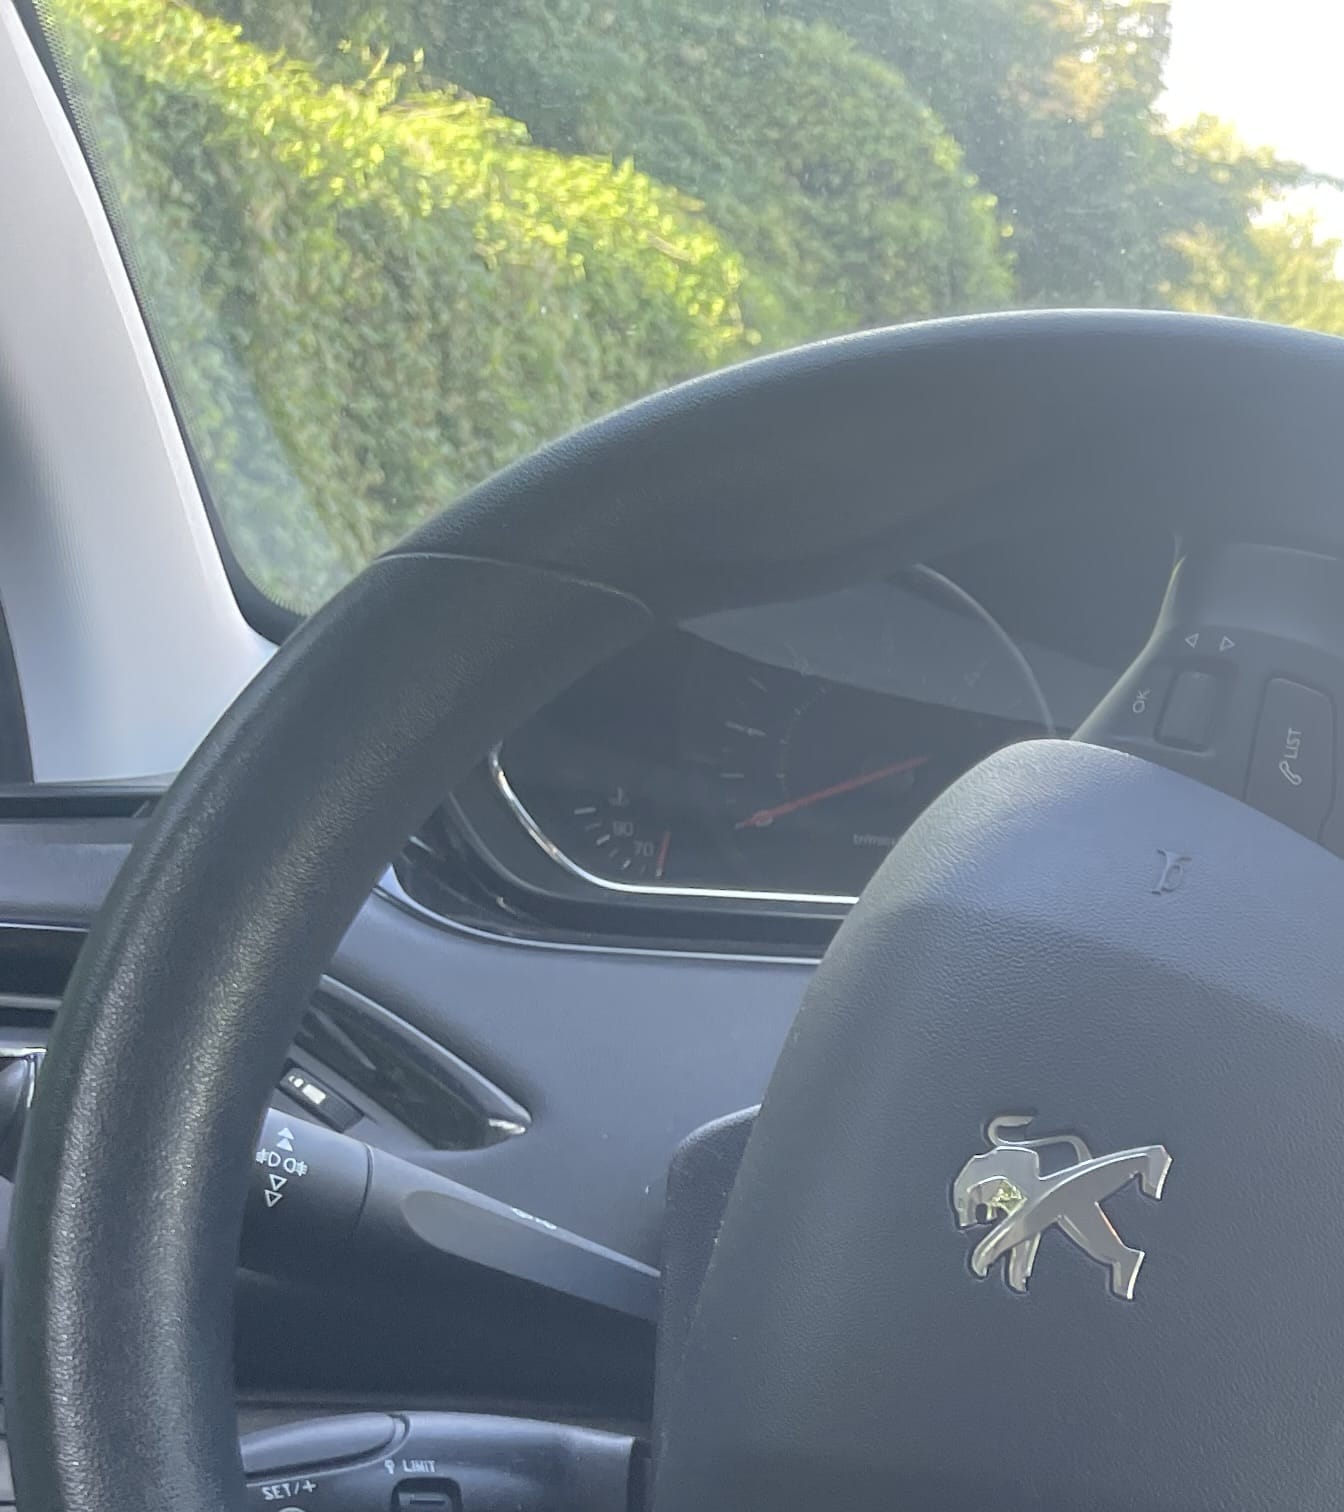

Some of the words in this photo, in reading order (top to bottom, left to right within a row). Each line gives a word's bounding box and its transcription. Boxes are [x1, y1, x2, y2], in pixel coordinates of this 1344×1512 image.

[1132, 688, 1151, 714] OK
[1283, 727, 1302, 759] LIST
[401, 1459, 436, 1474] LIMIT
